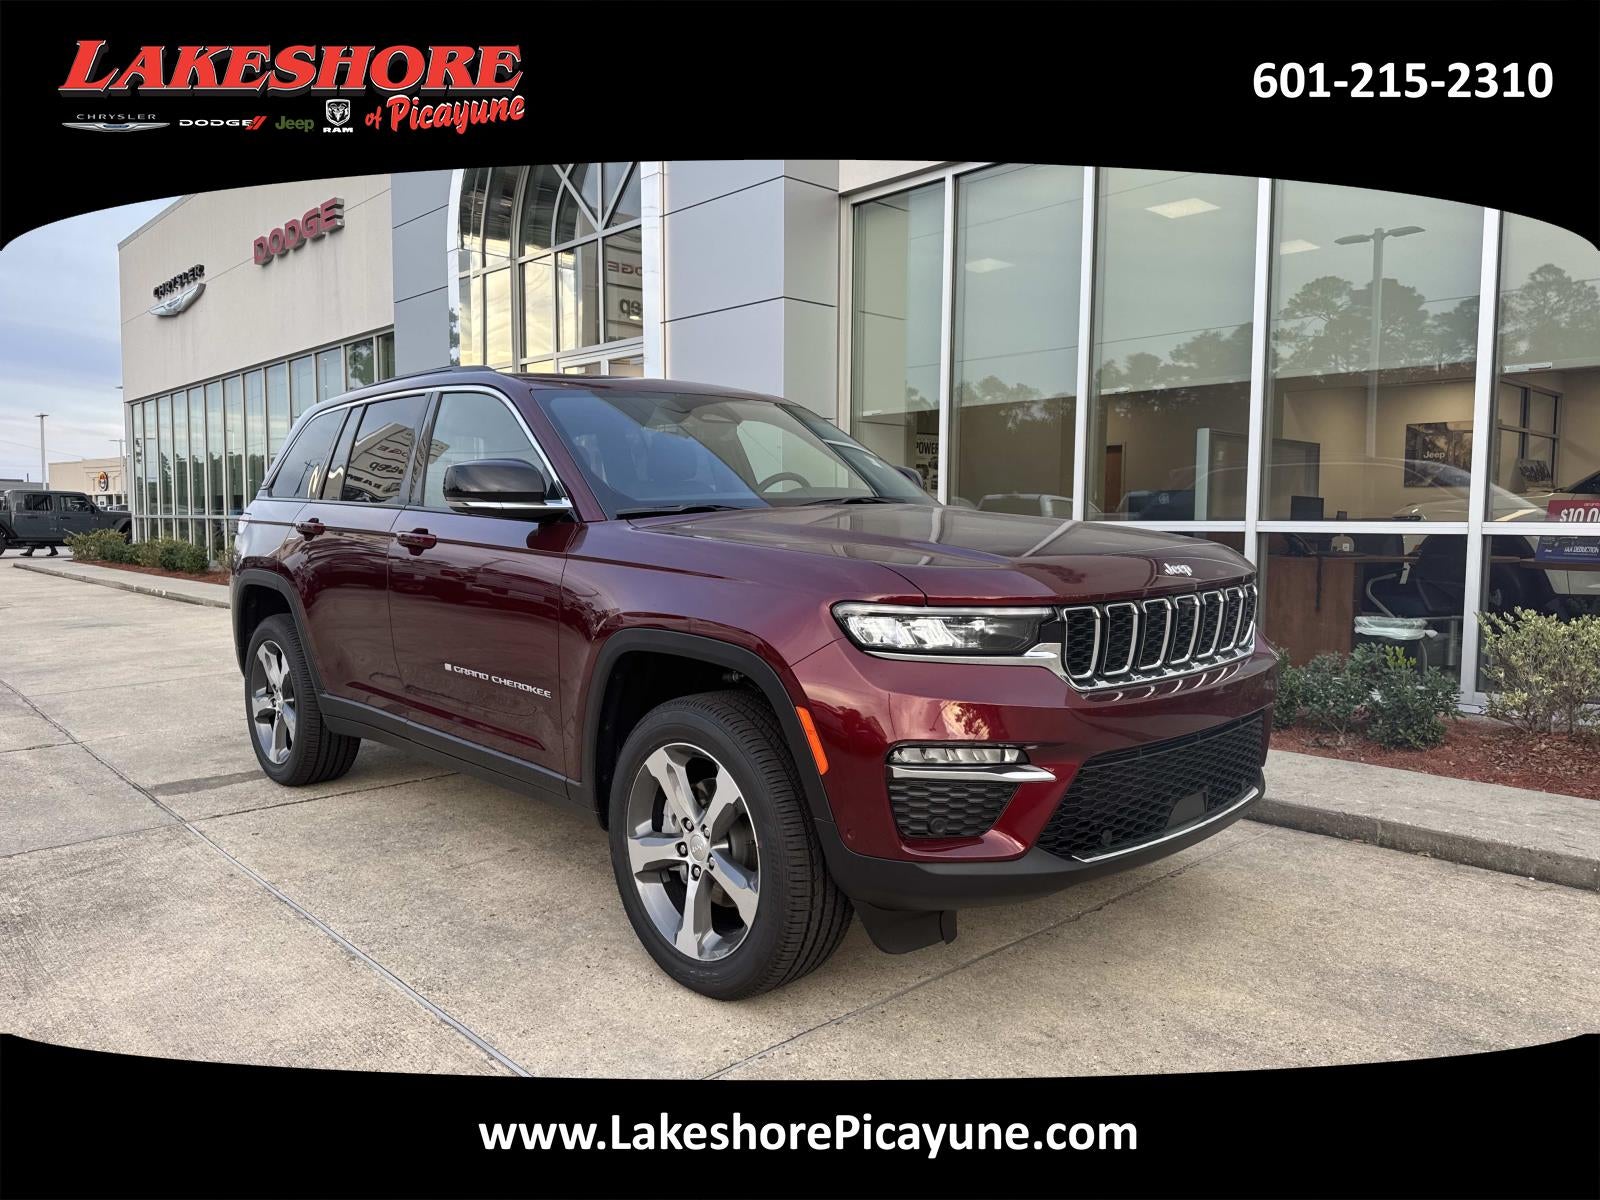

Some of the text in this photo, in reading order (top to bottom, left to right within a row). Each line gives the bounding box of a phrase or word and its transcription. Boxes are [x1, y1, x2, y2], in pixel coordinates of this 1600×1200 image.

[253, 197, 345, 267] DODGE
[1423, 450, 1446, 459] Jeep
[1164, 562, 1193, 577] Jeep
[453, 665, 552, 699] GRAND CHEROKEE
